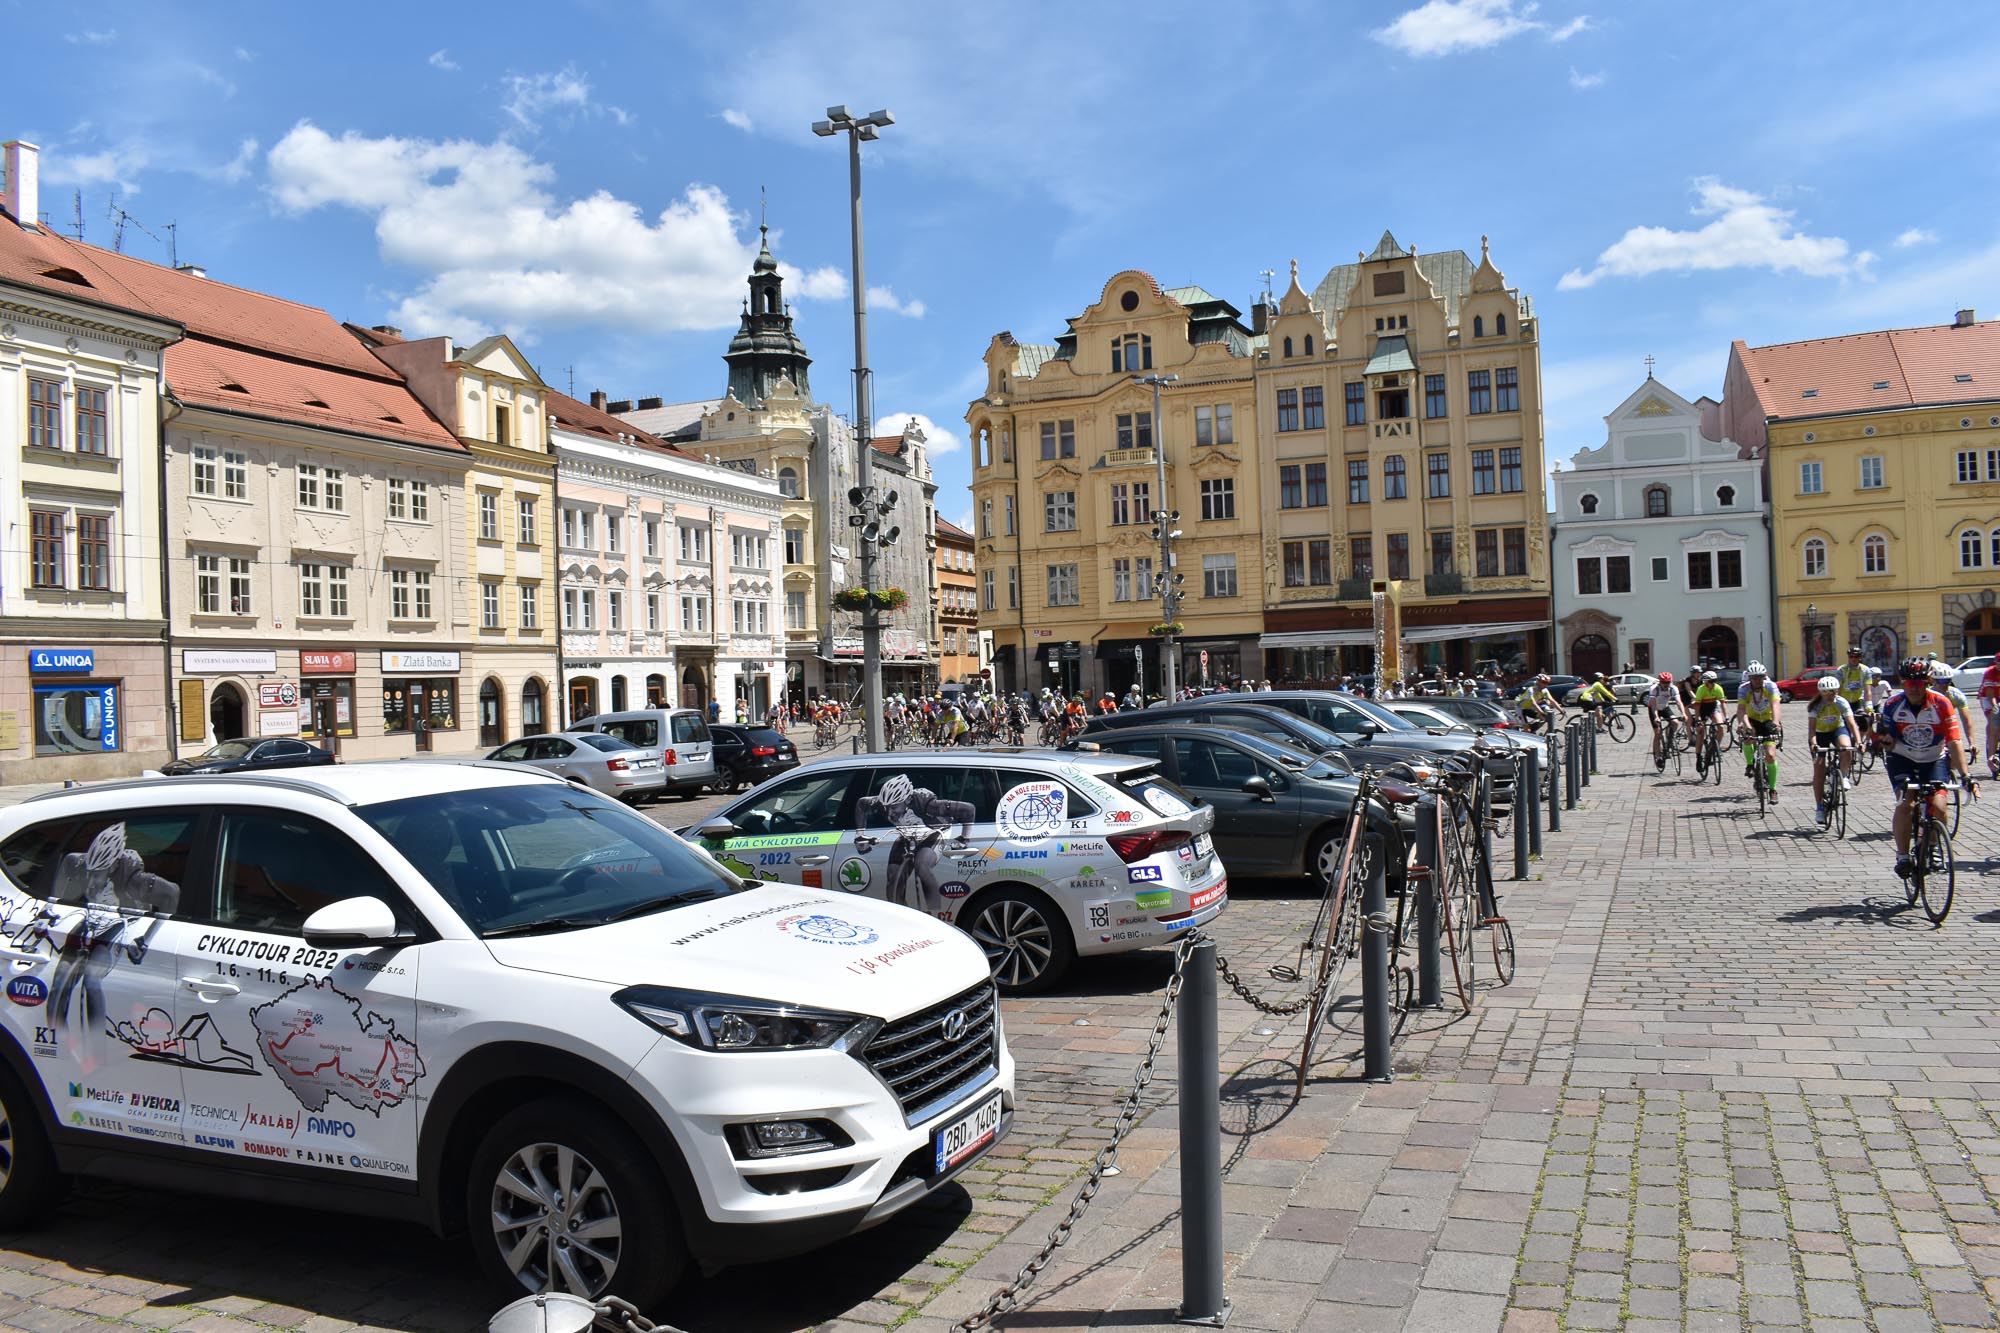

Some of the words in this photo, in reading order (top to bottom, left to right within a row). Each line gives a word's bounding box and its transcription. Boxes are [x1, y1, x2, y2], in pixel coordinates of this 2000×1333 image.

[54, 655, 92, 667] UNIQA
[304, 655, 329, 665] SLAVIA
[403, 655, 425, 667] Zlatá
[427, 656, 452, 667] Banka
[105, 687, 114, 728] UNIQA
[1006, 793, 1015, 803] NA
[1015, 785, 1030, 796] KOLE
[1104, 811, 1143, 823] SMO
[1070, 820, 1088, 829] K1
[752, 836, 819, 847] CYKLOTOUR
[1006, 830, 1019, 841] FOR
[1020, 831, 1050, 843] CHILDREN
[1070, 842, 1104, 851] MetLife
[760, 852, 791, 866] 2022
[1004, 850, 1048, 860] ALFUN
[957, 859, 989, 868] PALETY
[944, 885, 965, 893] VITA
[1070, 880, 1105, 888] KARETA
[1167, 918, 1196, 931] ALFUN
[1112, 932, 1126, 940] HIG
[1127, 931, 1140, 939] BIC
[197, 934, 290, 963] CYKLOTOUR
[292, 947, 339, 970] 2022
[357, 961, 387, 973] HIGBIC
[386, 966, 406, 976] s.r.o.
[257, 967, 276, 984] 11.
[279, 971, 290, 986] 6.
[14, 982, 40, 997] VITA
[297, 1008, 313, 1017] Praha
[34, 1026, 58, 1045] K1
[87, 1087, 124, 1105] MetLife
[142, 1094, 180, 1112] VEKRA
[127, 1108, 147, 1120] OKNA
[190, 1103, 238, 1122] TECHNICAL
[88, 1115, 123, 1132] KARETA
[249, 1112, 294, 1130] KALÁB
[307, 1116, 356, 1138] AMPO
[946, 1122, 966, 1156] 2BD
[975, 1100, 997, 1136] 1406
[194, 1134, 236, 1149] ALFUN
[296, 1149, 345, 1165] FAJNE
[361, 1158, 410, 1175] QUALIFORM
